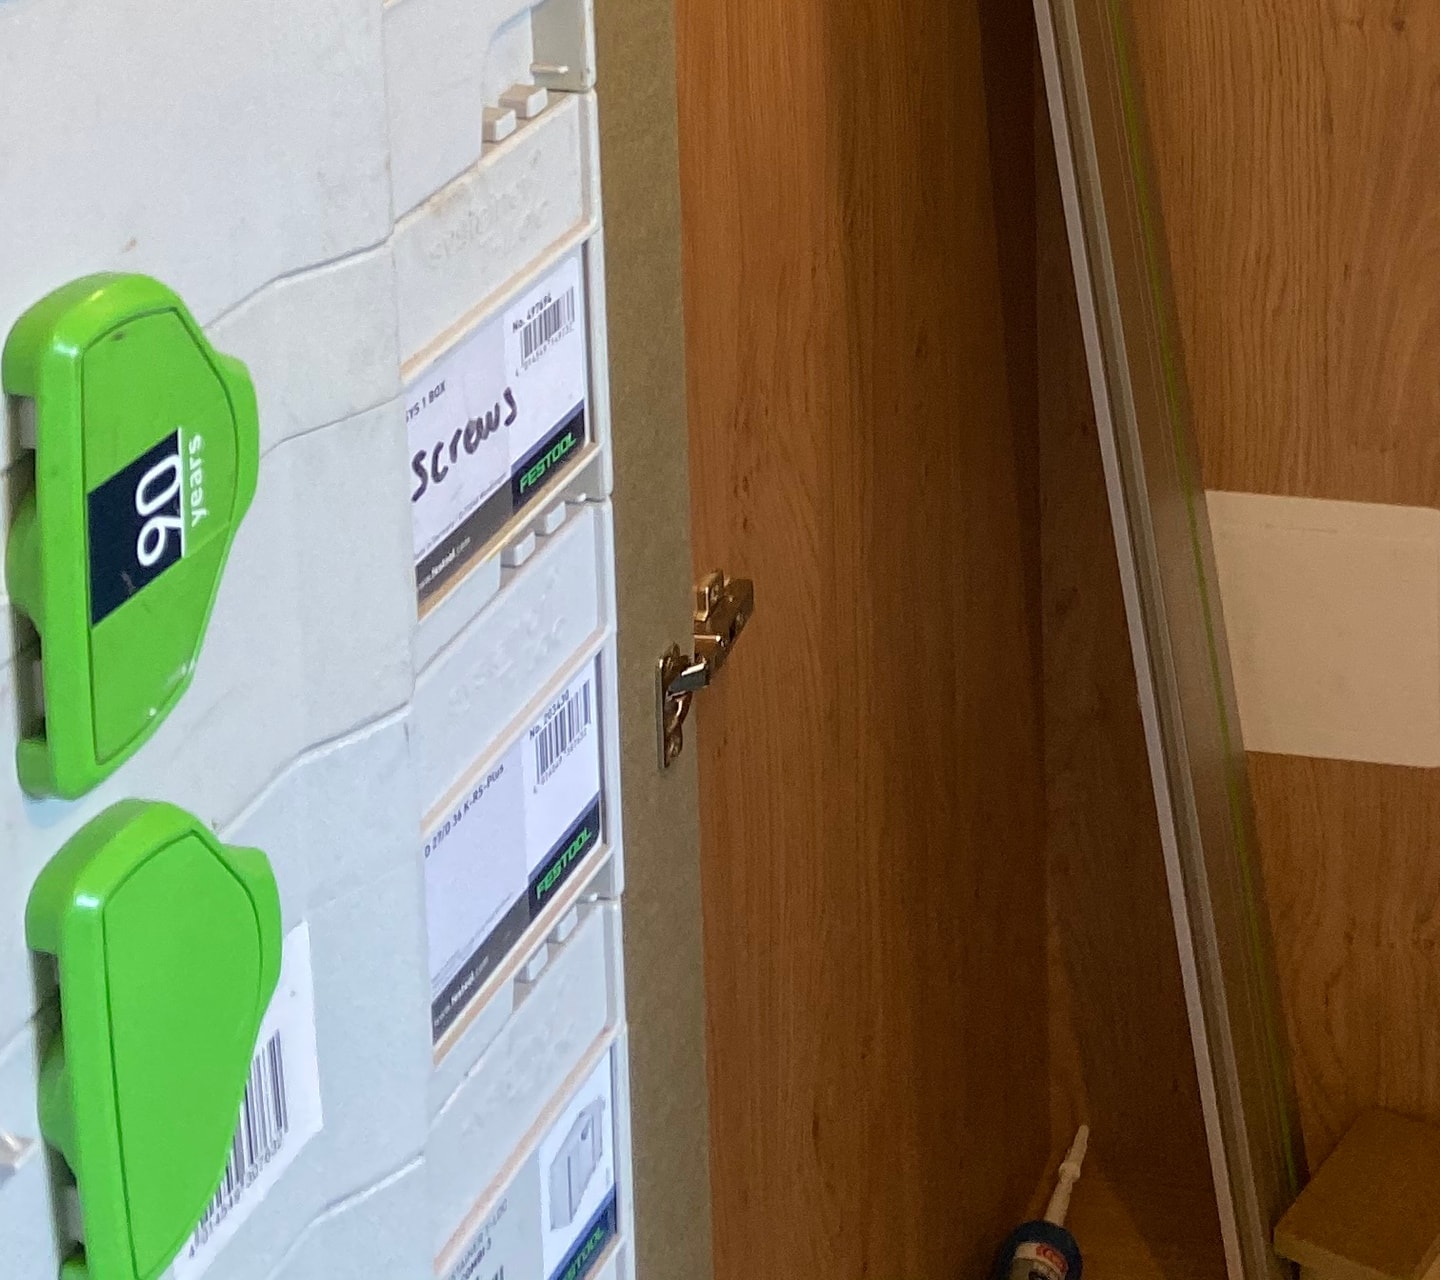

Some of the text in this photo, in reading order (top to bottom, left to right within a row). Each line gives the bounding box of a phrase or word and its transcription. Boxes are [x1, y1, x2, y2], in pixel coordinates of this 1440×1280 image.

[428, 380, 446, 404] BOX
[188, 434, 208, 528] years
[520, 432, 577, 494] FESTOOL
[136, 454, 183, 567] 90
[452, 809, 462, 827] 36
[536, 827, 593, 901] FESTOOL
